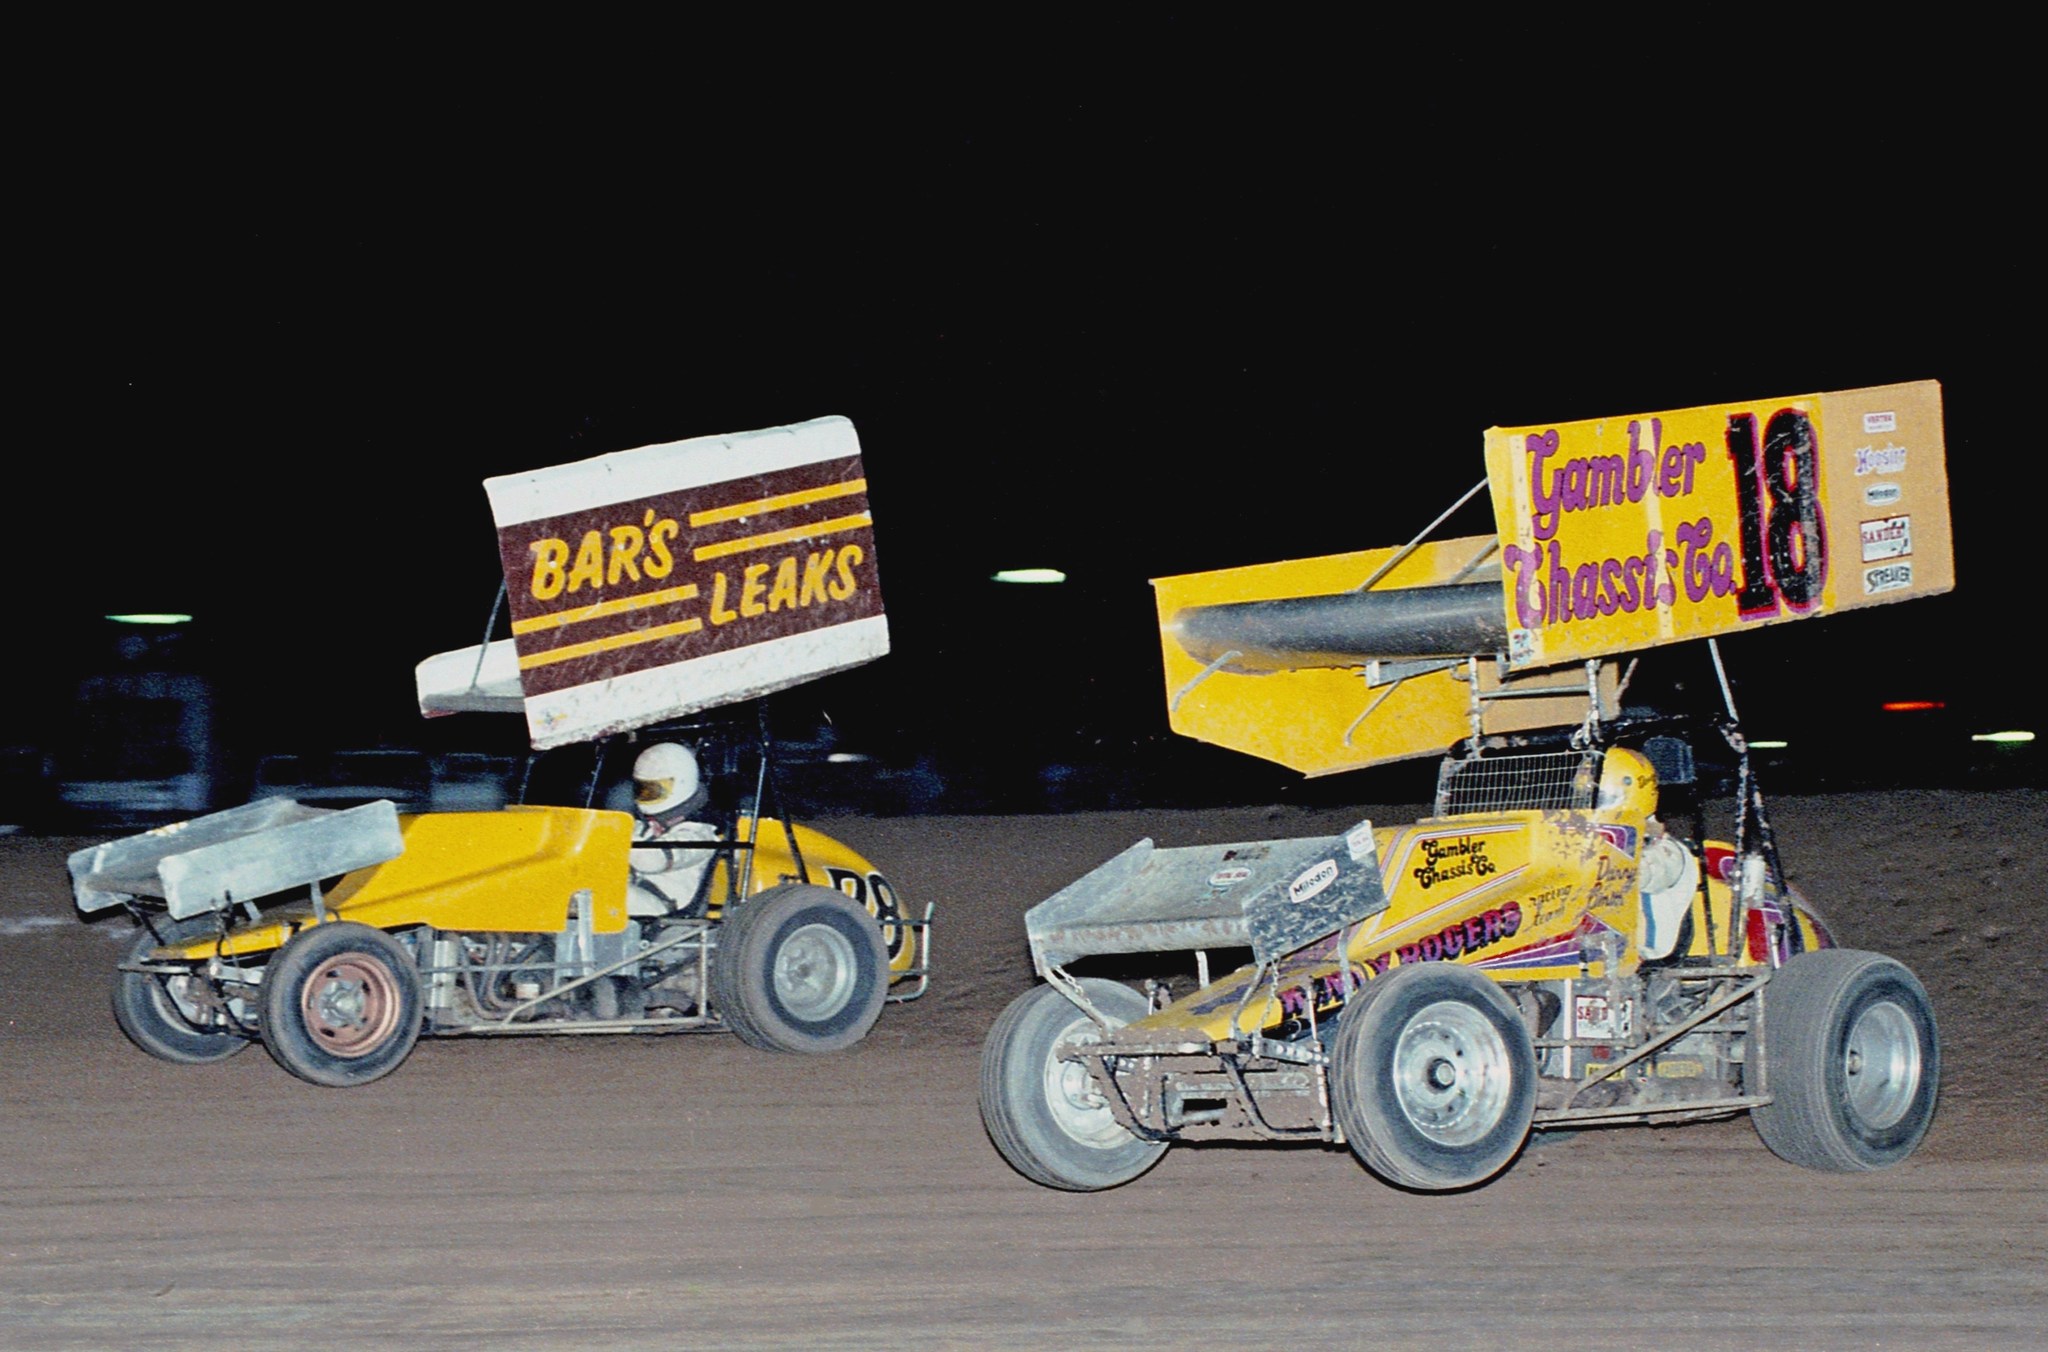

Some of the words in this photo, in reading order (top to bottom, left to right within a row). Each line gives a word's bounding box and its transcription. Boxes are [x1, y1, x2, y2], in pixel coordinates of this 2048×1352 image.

[1526, 418, 1706, 541] Gambler
[1725, 408, 1829, 622] 18
[529, 509, 679, 601] BAR'S
[709, 544, 863, 627] LEAKS
[1503, 529, 1680, 630] Chassis
[1413, 859, 1474, 890] Chassis
[1421, 836, 1486, 867] Gambler
[1395, 901, 1523, 962] ROGERS
